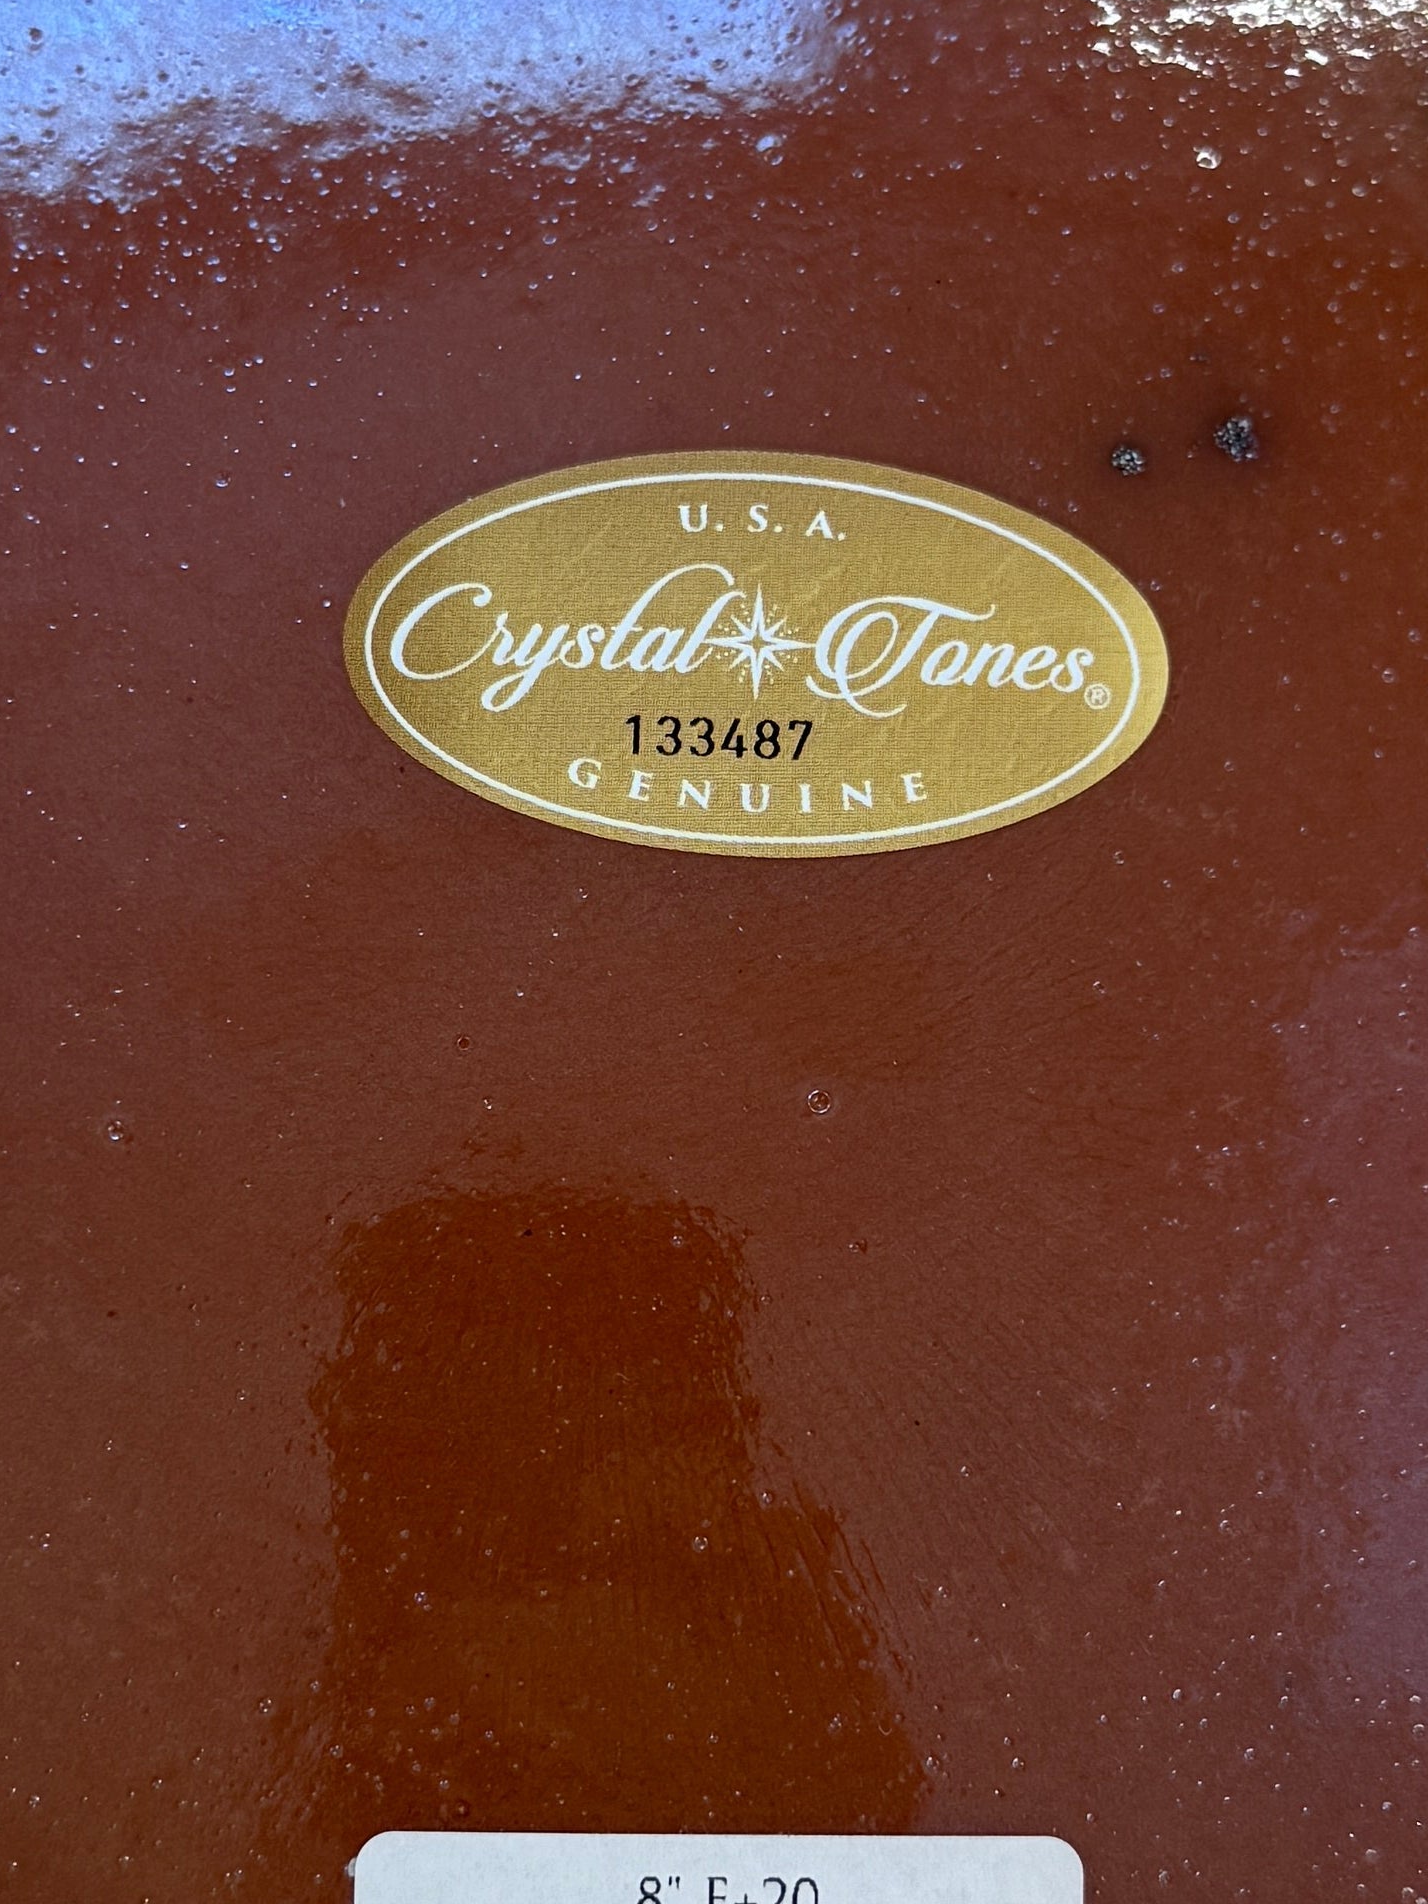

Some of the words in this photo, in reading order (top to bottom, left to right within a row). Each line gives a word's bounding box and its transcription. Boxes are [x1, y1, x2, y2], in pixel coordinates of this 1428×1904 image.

[389, 561, 747, 713] Crystal
[624, 713, 815, 763] 133487
[566, 757, 931, 815] GENUINE
